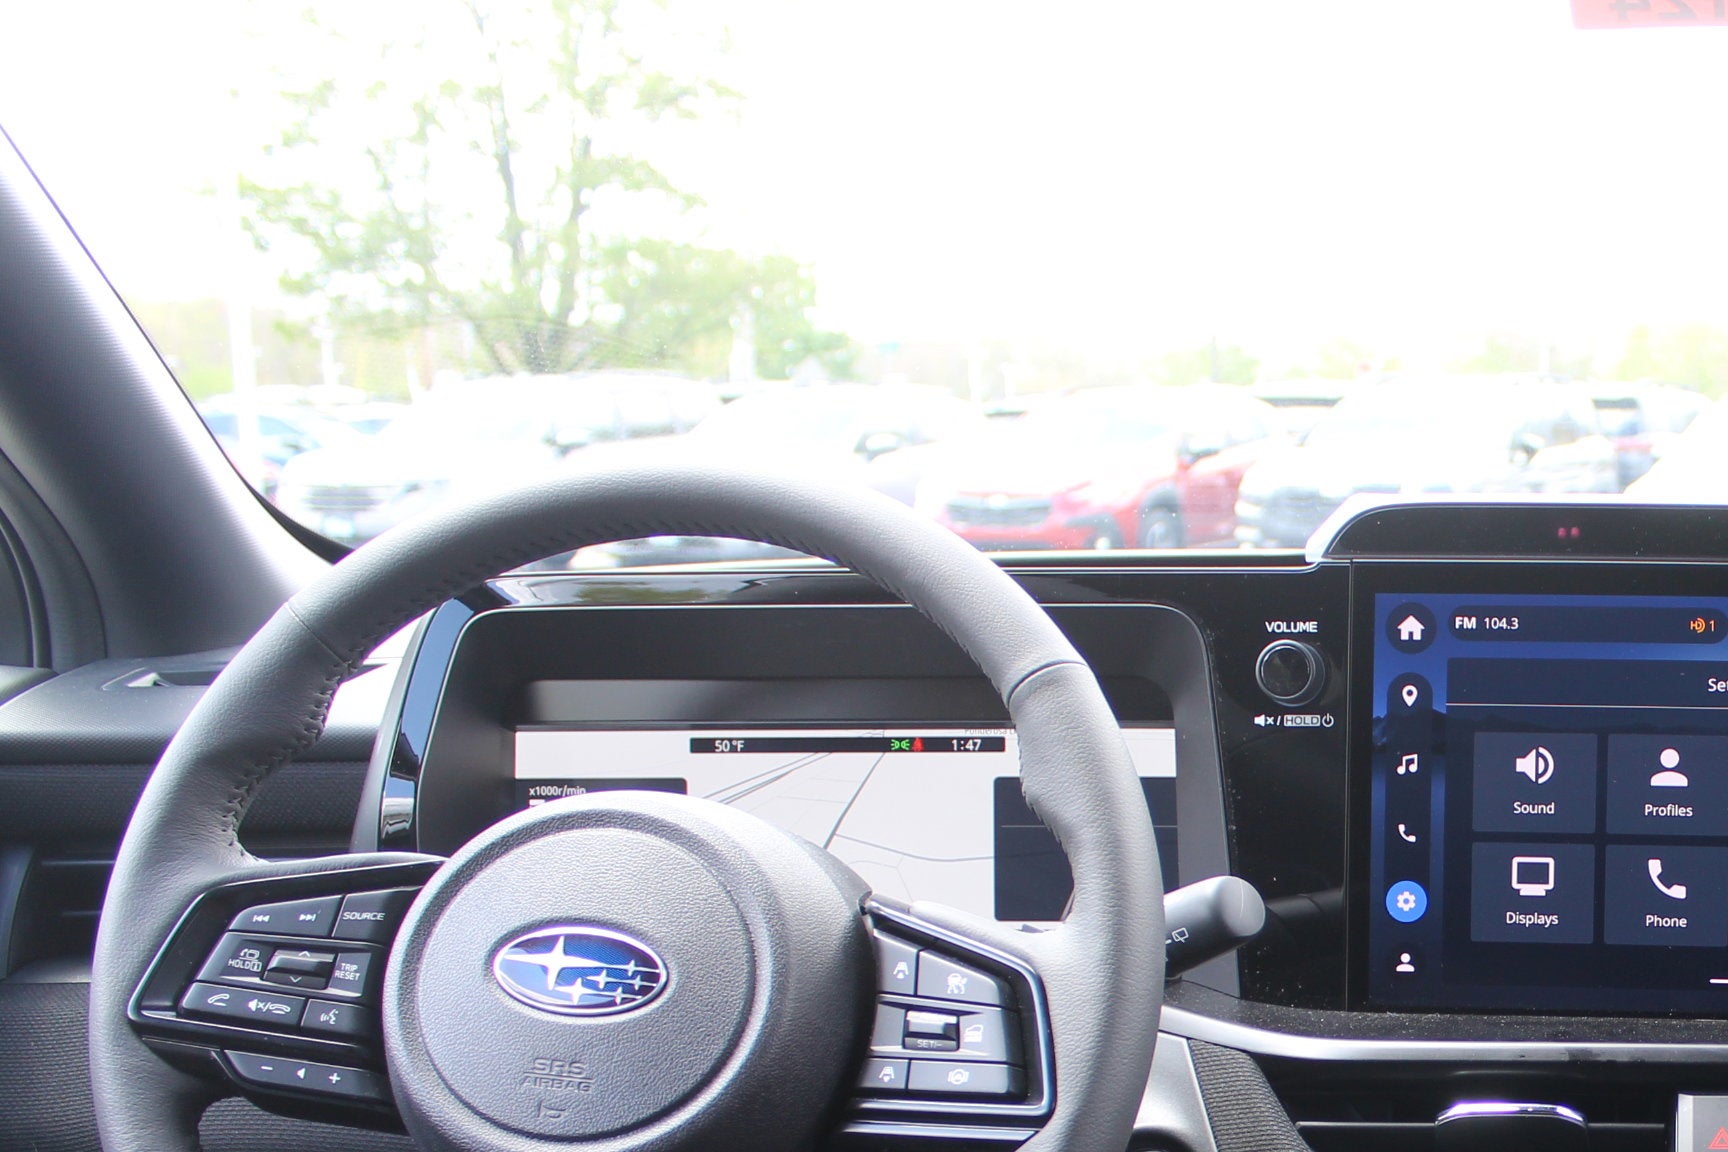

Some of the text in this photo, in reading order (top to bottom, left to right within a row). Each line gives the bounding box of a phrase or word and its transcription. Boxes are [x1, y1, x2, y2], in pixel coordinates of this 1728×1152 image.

[1265, 621, 1318, 632] VOLUME
[1454, 617, 1476, 629] FM
[1483, 617, 1519, 630] 104.3
[1286, 716, 1319, 726] HOLD
[952, 739, 982, 752] 1:47
[528, 784, 586, 797] x1000r/min
[1513, 802, 1555, 814] Sound
[1644, 804, 1694, 817] Profiles
[342, 912, 386, 921] SOURCE
[1506, 912, 1558, 928] Displays
[1646, 915, 1688, 927] Phone
[228, 959, 250, 970] HOLD
[340, 962, 358, 972] TRIP
[334, 970, 360, 981] RESET
[532, 1058, 587, 1077] SRS
[522, 1076, 593, 1093] AIRBAG
